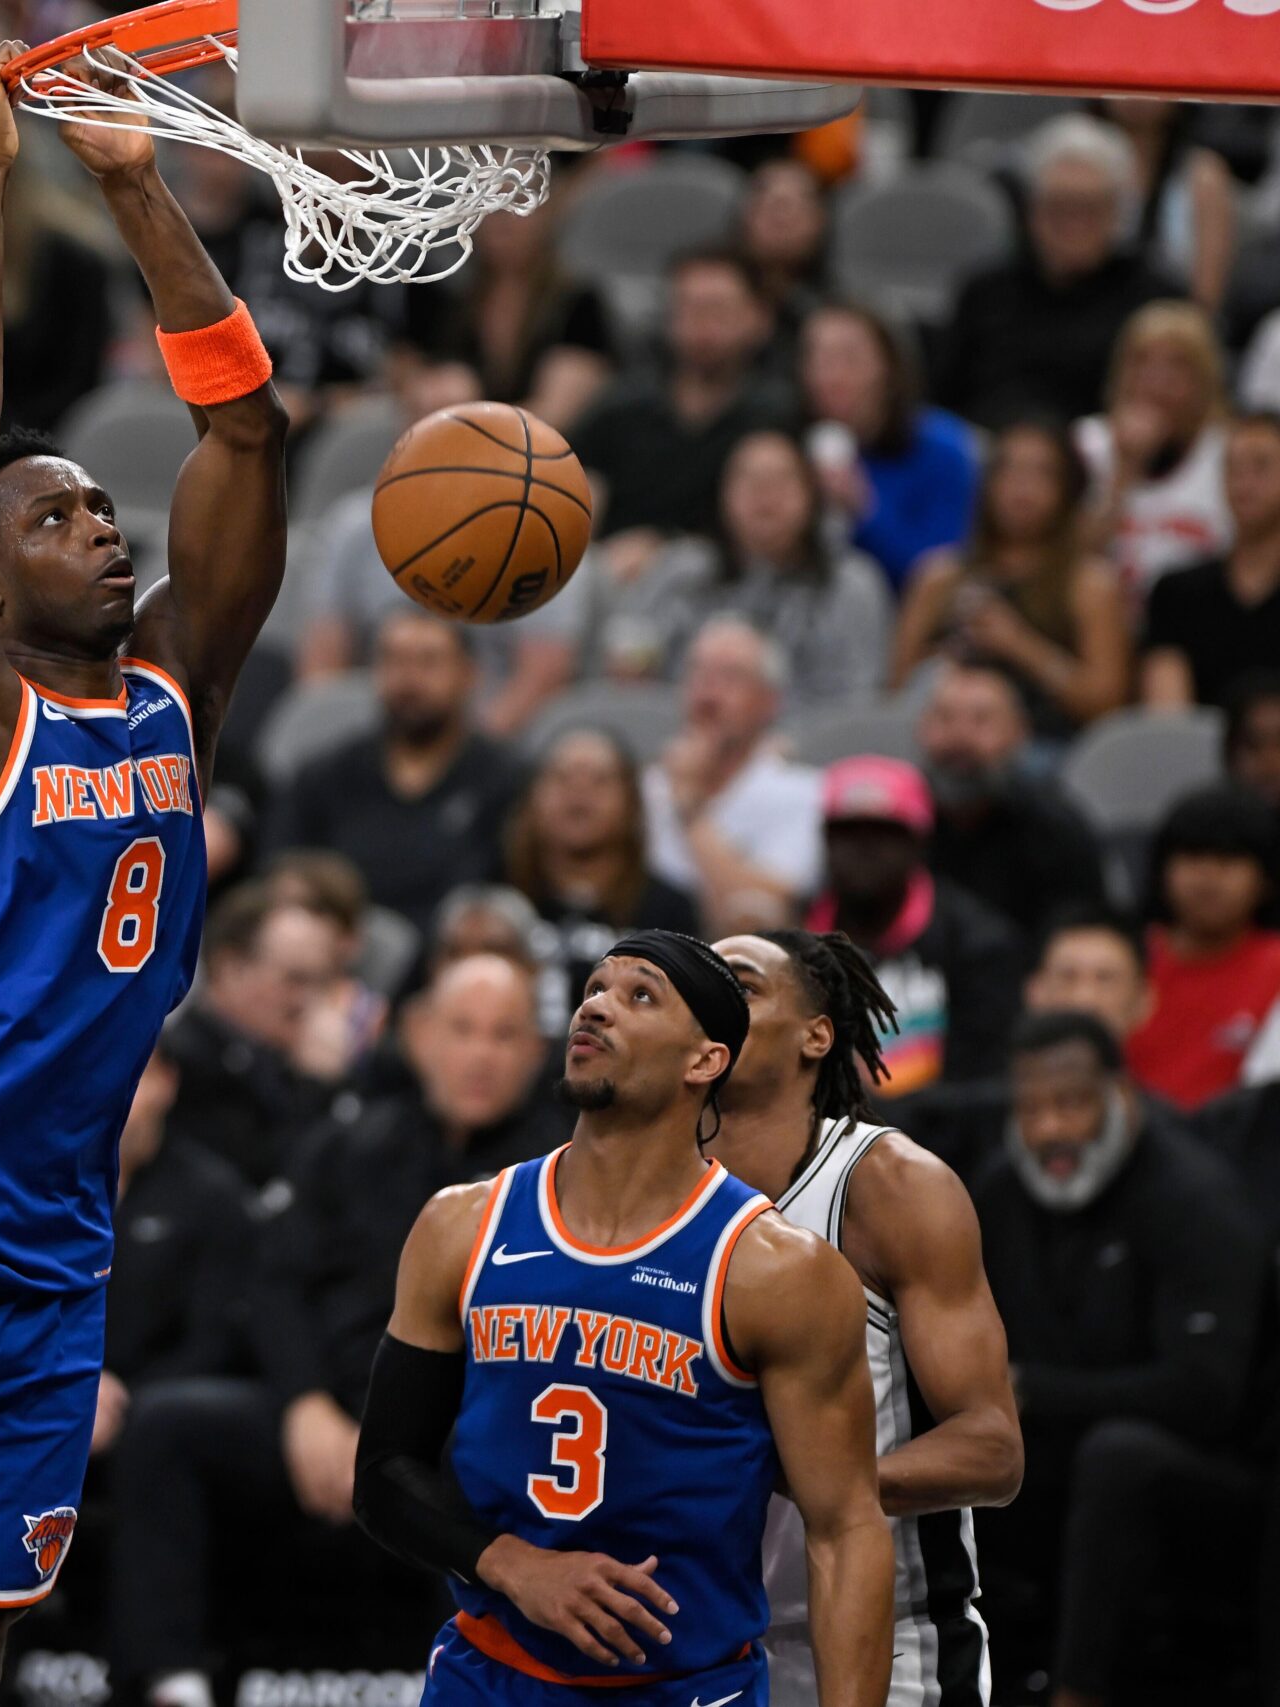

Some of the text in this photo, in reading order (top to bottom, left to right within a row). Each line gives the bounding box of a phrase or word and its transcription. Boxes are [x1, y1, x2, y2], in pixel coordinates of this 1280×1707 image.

[128, 694, 173, 730] abu dhabi
[32, 753, 194, 827] NEW ORK
[97, 836, 167, 973] 8
[631, 1271, 698, 1294] abu dhabi
[469, 1304, 705, 1399] NEW YORK
[526, 1382, 608, 1522] 3
